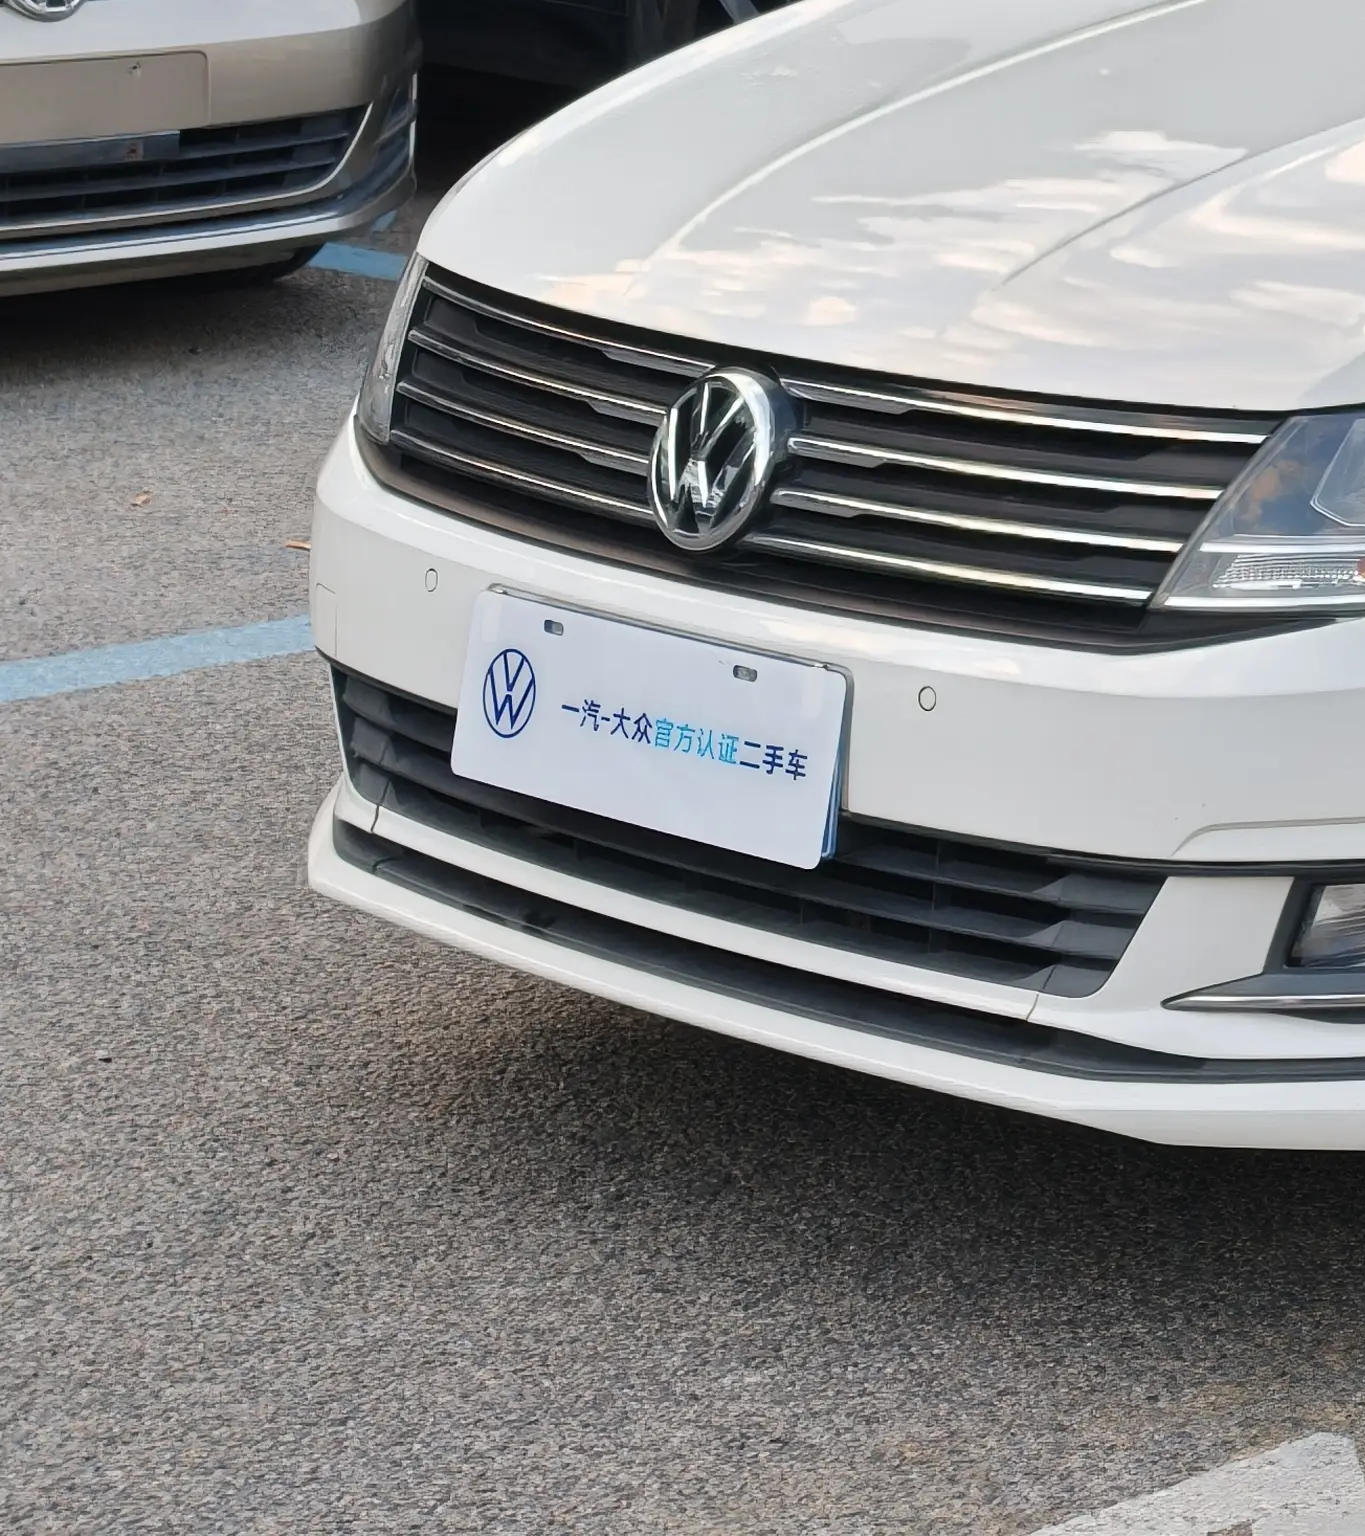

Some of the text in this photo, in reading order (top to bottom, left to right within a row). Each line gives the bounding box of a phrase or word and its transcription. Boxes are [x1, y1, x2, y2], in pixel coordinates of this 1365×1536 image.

[483, 648, 537, 738] VW
[561, 699, 808, 780] 一汽-大众官方认证二手车
